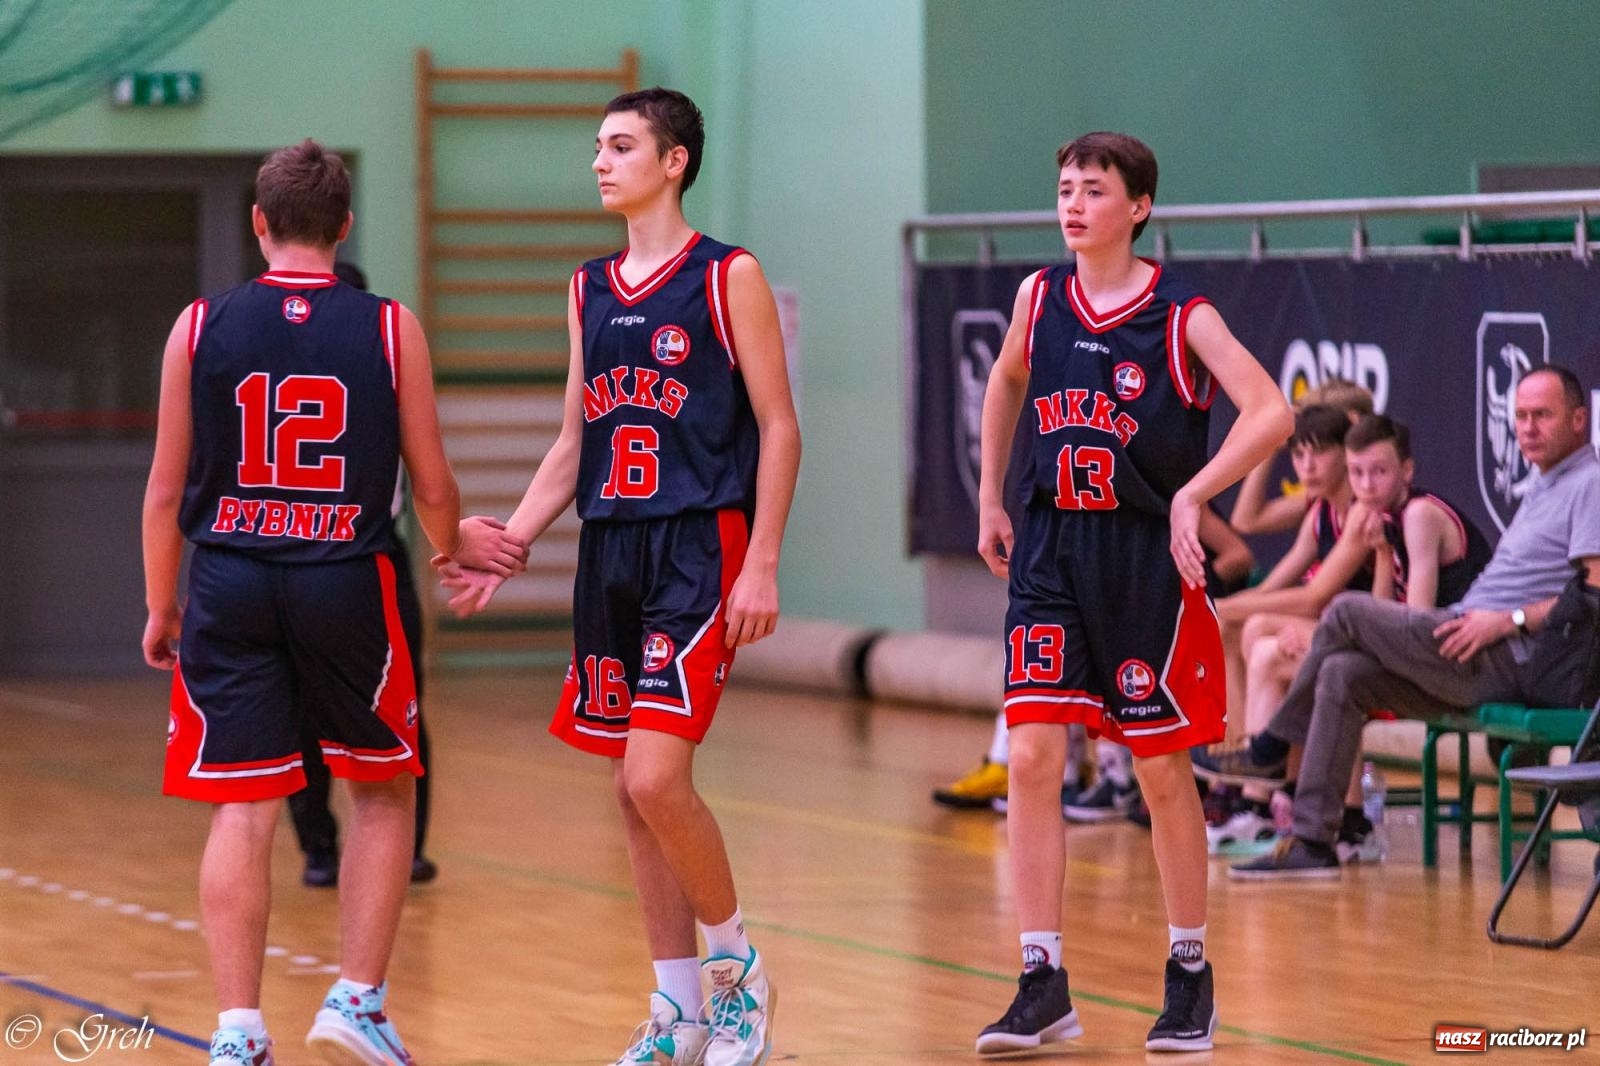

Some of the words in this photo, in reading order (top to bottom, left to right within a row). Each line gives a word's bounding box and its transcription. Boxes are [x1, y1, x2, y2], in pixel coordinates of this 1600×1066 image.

[611, 314, 646, 326] regio
[1074, 340, 1110, 354] regio
[235, 372, 348, 492] 12
[1034, 389, 1139, 448] MKKS
[600, 424, 660, 499] 16
[1055, 444, 1120, 511] 13
[211, 496, 361, 541] RYBNIK
[1008, 624, 1066, 686] 13
[584, 654, 633, 720] 16
[1121, 705, 1162, 716] regio
